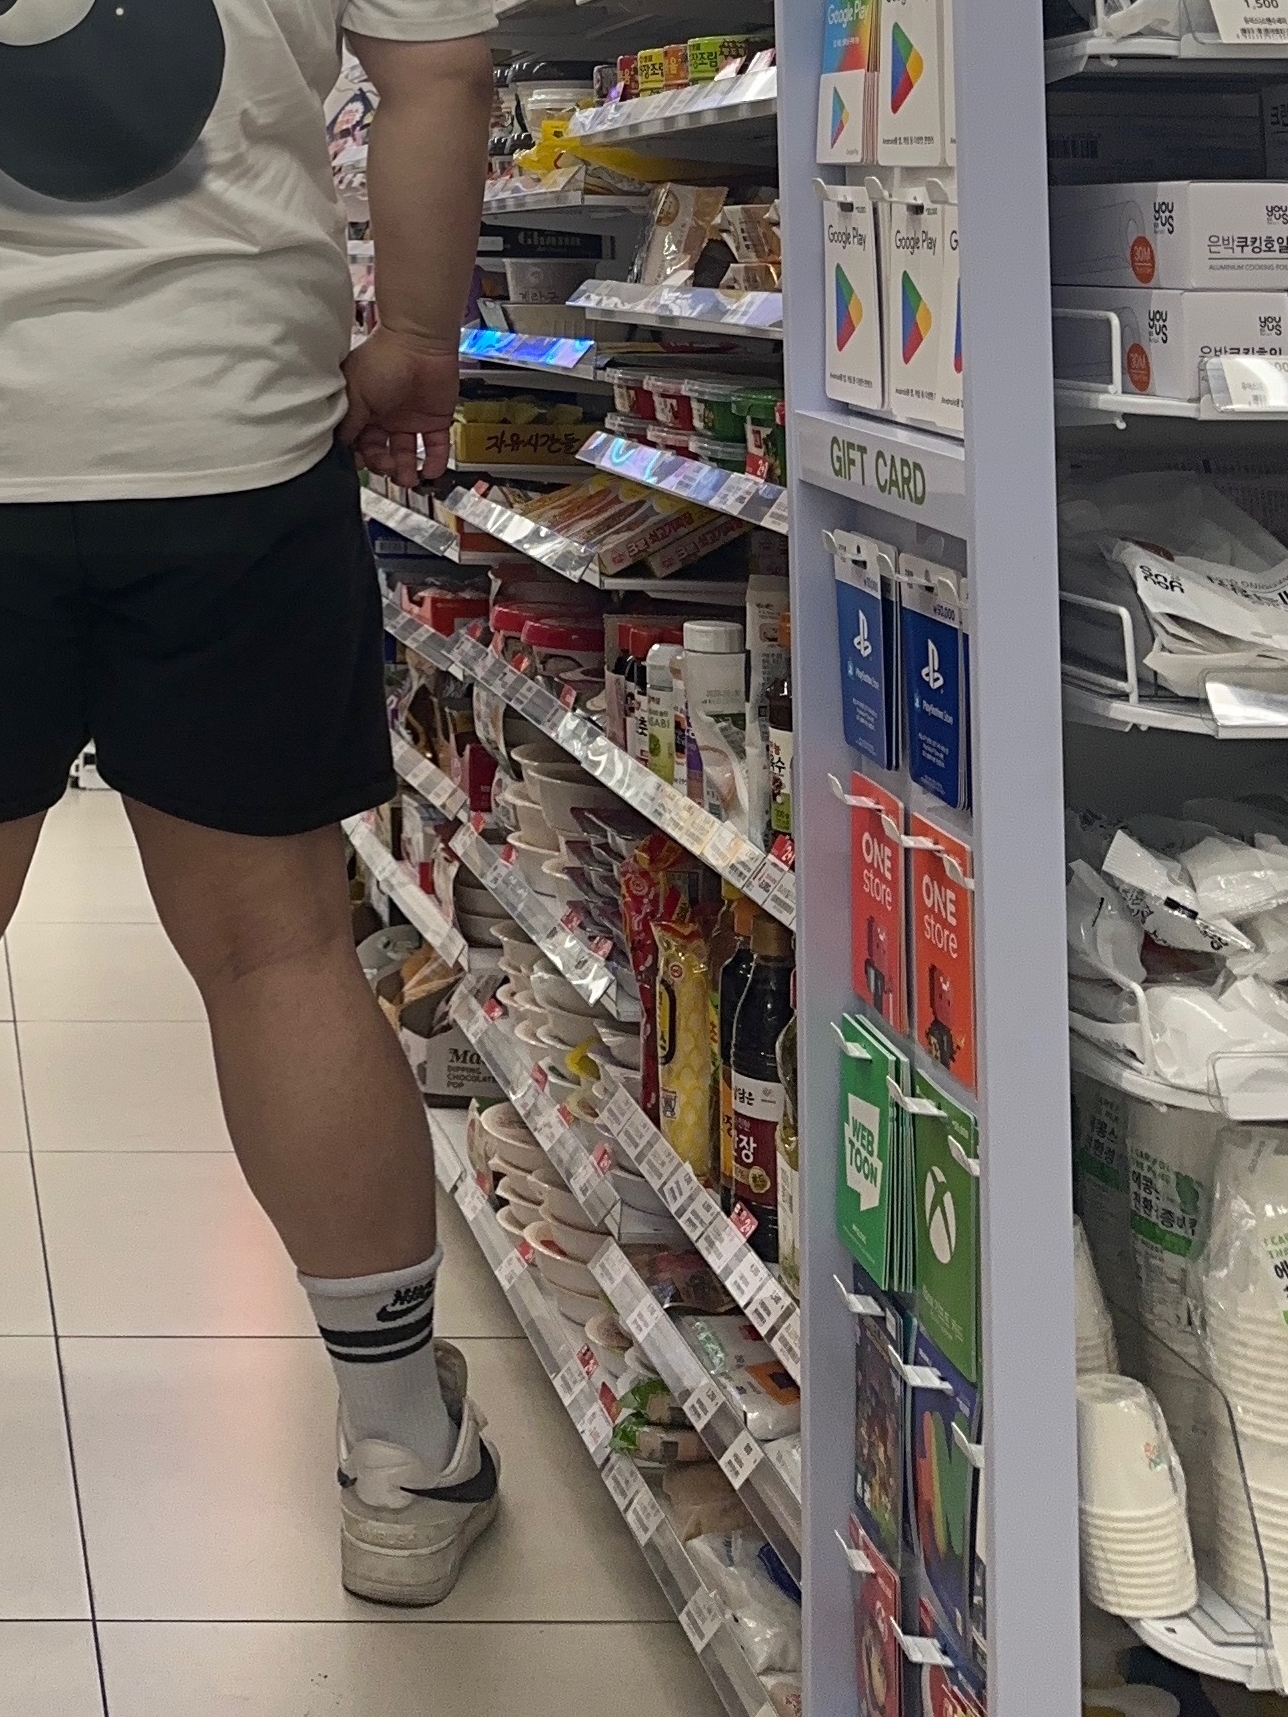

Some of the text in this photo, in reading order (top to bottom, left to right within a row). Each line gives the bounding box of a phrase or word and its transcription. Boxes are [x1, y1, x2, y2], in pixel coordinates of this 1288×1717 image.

[827, 0, 870, 28] Google Play
[1153, 201, 1175, 222] you
[827, 224, 867, 252] Google Play
[894, 230, 937, 256] Google Play
[1206, 234, 1288, 255] 은박쿠킹호일
[1148, 309, 1168, 329] you
[1258, 315, 1281, 331] you
[830, 435, 927, 508] GIFT CARD
[860, 830, 894, 878] ONE
[862, 866, 894, 912] store
[922, 875, 958, 927] ONE
[923, 911, 959, 959] store
[851, 1116, 876, 1159] WEB
[848, 1139, 880, 1189] TOON
